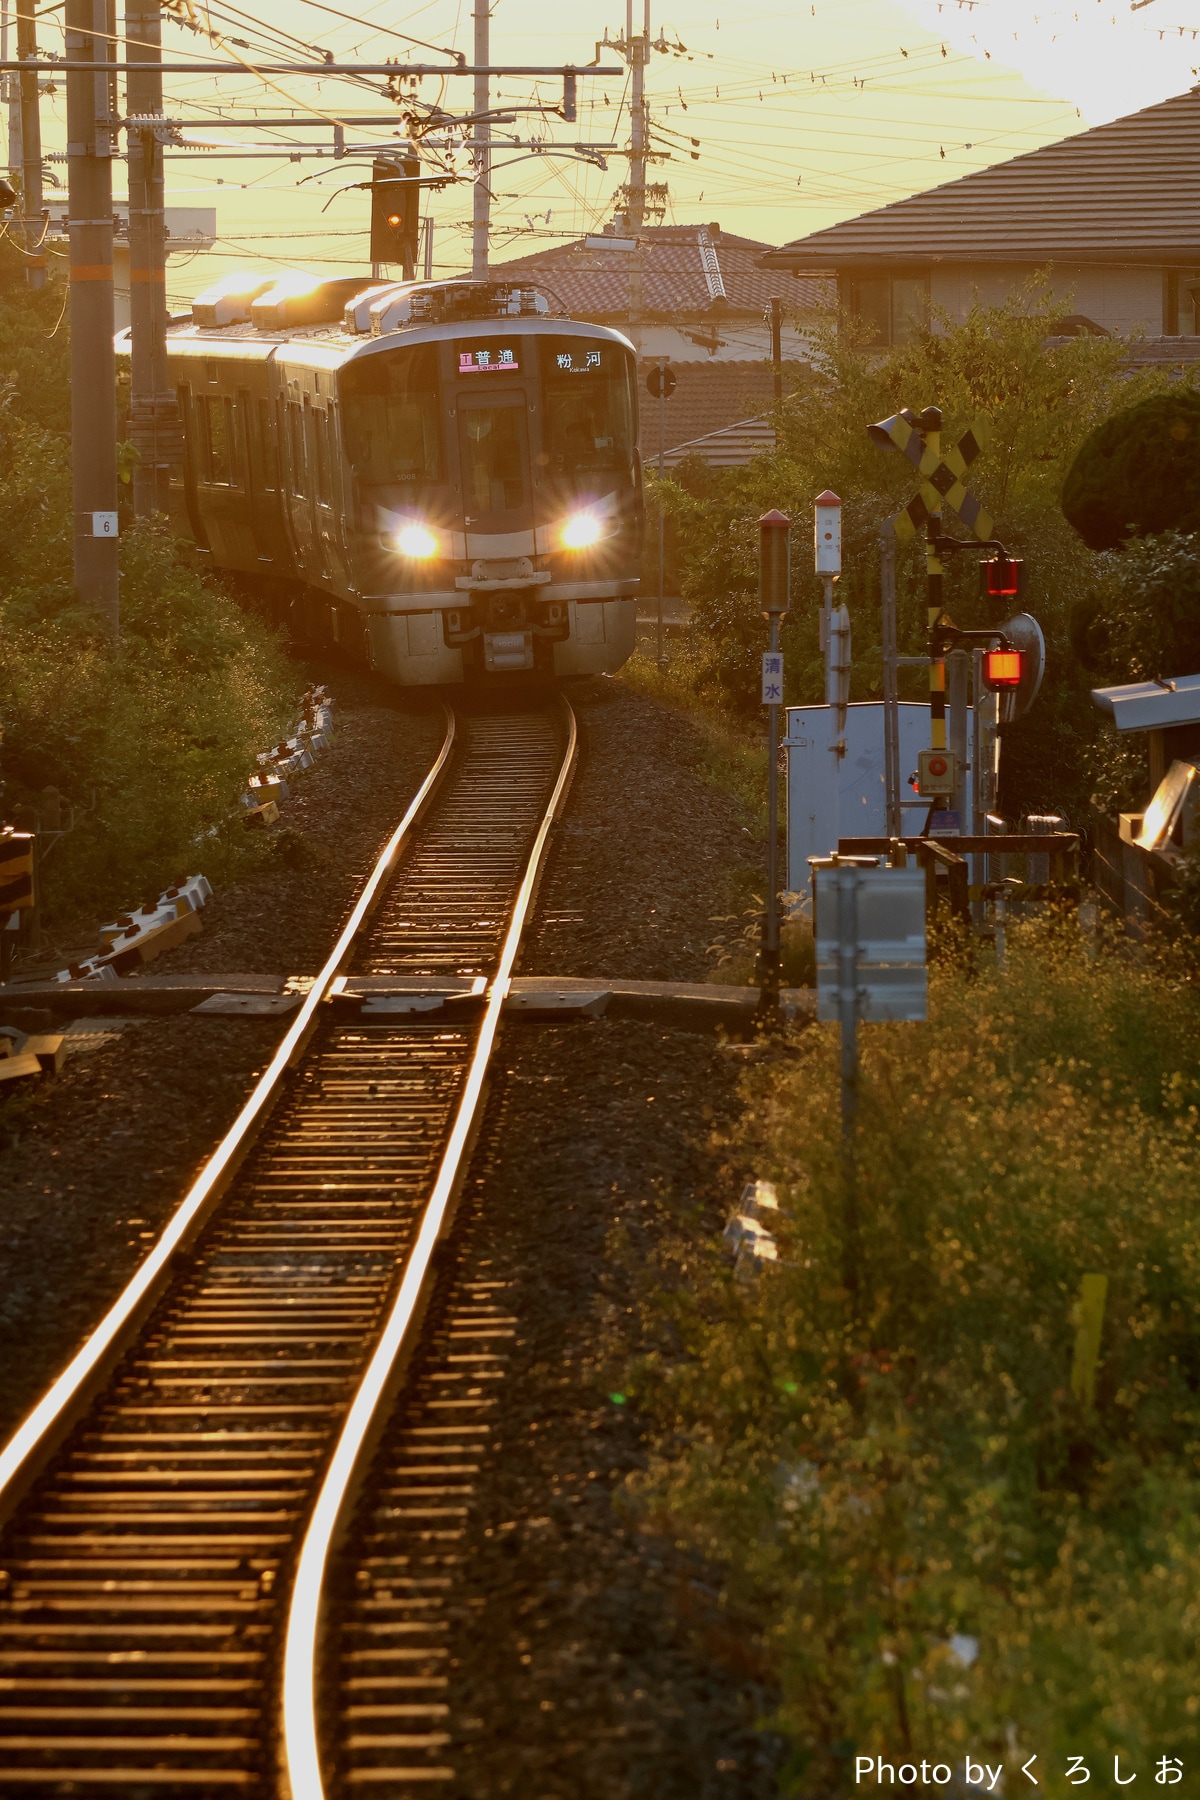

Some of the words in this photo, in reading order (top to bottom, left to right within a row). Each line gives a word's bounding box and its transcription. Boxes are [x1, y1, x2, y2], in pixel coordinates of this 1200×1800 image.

[475, 349, 514, 364] 普通
[556, 351, 601, 368] 粉河
[104, 521, 110, 532] 6
[764, 658, 780, 699] 清水
